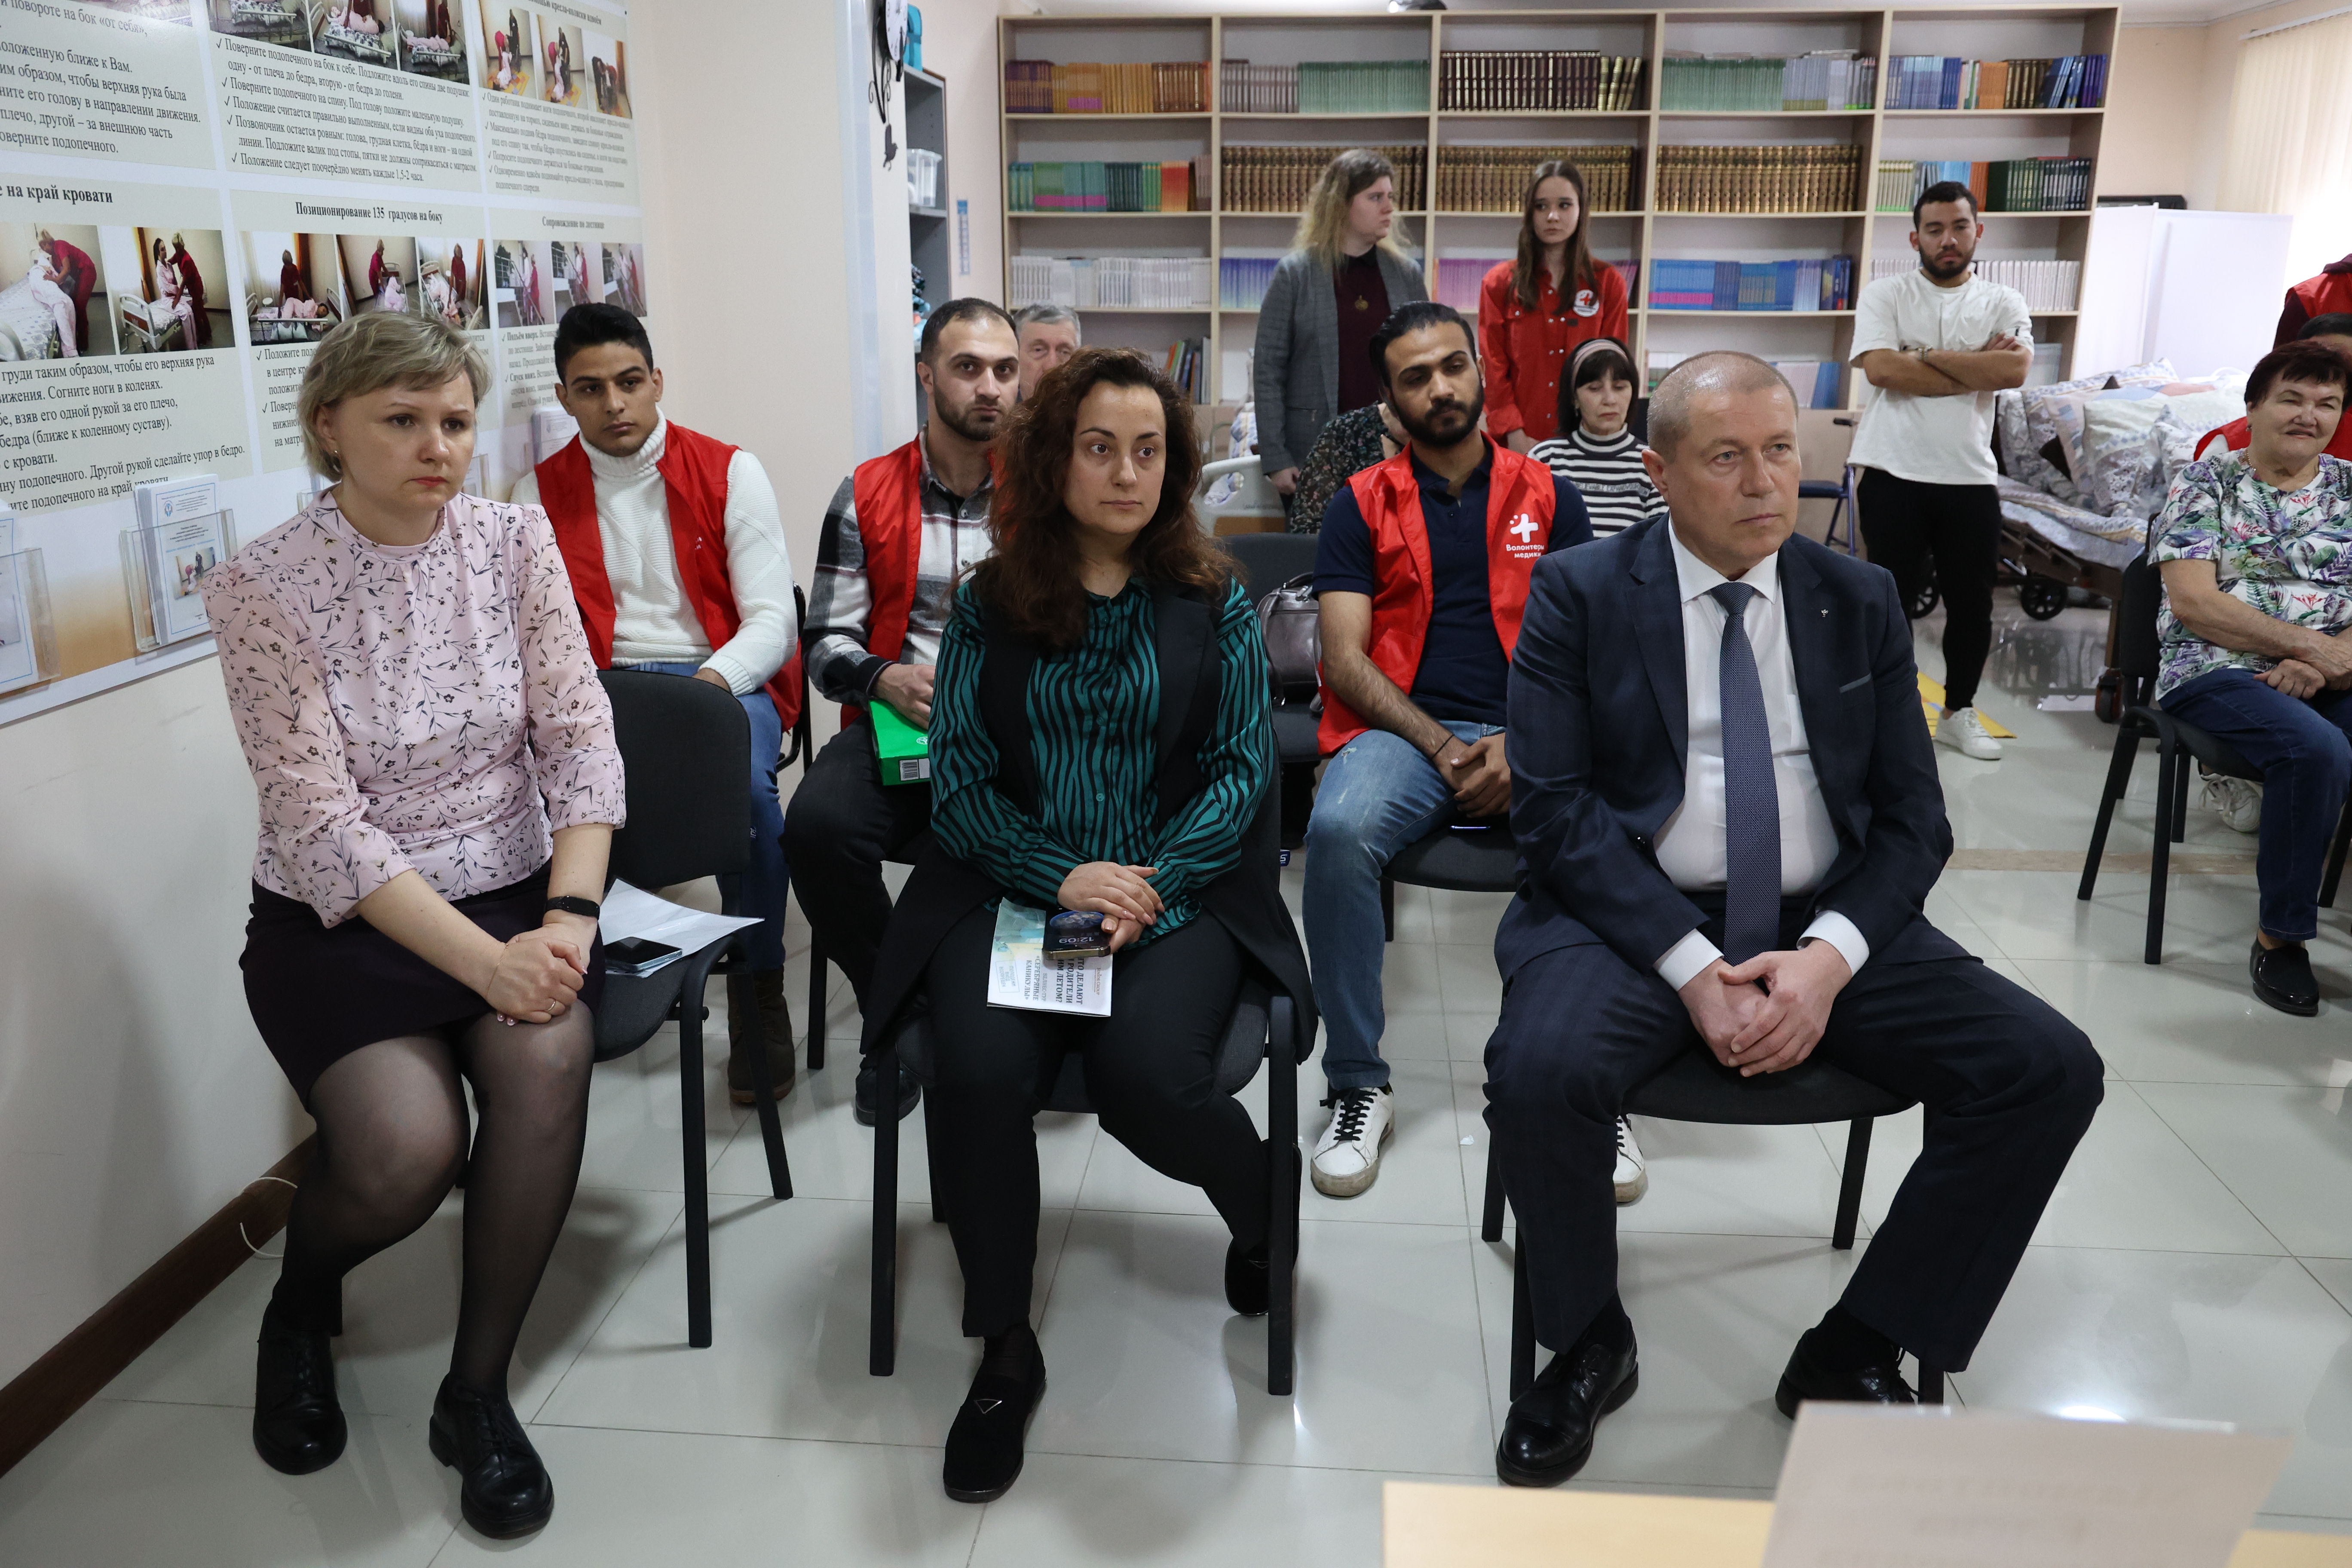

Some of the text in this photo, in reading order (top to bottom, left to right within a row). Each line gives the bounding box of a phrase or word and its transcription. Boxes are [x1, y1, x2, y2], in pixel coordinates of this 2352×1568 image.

[11, 0, 61, 17] повороте
[63, 9, 77, 20] на
[78, 9, 97, 24] бок
[99, 17, 116, 28] «от
[0, 42, 133, 72] оложенную ближе Вам.
[225, 38, 266, 57] Поверните
[268, 50, 312, 66] подопечного
[313, 59, 322, 68] на
[323, 58, 335, 70] бок
[342, 63, 358, 75] себе.
[358, 65, 392, 81] Подложите
[393, 74, 409, 84] вдоль
[18, 64, 66, 84] образом,
[67, 74, 100, 88] чтобы
[102, 80, 140, 94] верхняя
[141, 86, 163, 99] рука
[164, 86, 187, 101] была
[228, 61, 404, 100] одну от плеча до бедра, вторую от бедра до голени.
[28, 90, 45, 101] его
[47, 93, 82, 110] голову
[84, 98, 91, 108] в
[93, 100, 154, 116] направлении
[156, 109, 201, 122] движения.
[230, 77, 441, 123] Поверните подопечного на спину. Под голову положите маленькую
[0, 109, 173, 138] плечо, другой за внешнюю часть
[233, 96, 424, 135] Положение считается правильно выполненным, если видны
[52, 138, 119, 152] подопечного.
[235, 115, 429, 153] Позвоночник остается ровным: голова, грудная клетка, бёдра
[239, 137, 264, 148] линии.
[265, 137, 306, 152] Подложите
[306, 145, 326, 155] валик
[327, 148, 340, 157] под
[340, 150, 361, 159] стопы,
[362, 152, 380, 161] пятки
[389, 155, 411, 164] должны
[241, 153, 283, 168] Положение
[284, 161, 310, 172] следует
[312, 163, 349, 175] поочерёдно
[350, 167, 372, 176] менять
[373, 169, 395, 178] каждые
[396, 169, 410, 180] 1,5-2
[6, 186, 113, 204] на край кровати
[295, 202, 442, 224] Позиционирование 135 градусов на боку
[264, 349, 300, 359] Положите
[1, 357, 215, 384] груди таким образом, чтобы его верхняя рука
[273, 367, 297, 378] центре
[48, 386, 90, 398] Согните
[92, 385, 115, 395] ноги
[125, 381, 163, 392] коленях.
[15, 413, 38, 424] взяв
[41, 411, 57, 421] его
[60, 404, 90, 419] одной
[92, 401, 120, 419] рукой
[122, 403, 132, 412] за
[134, 401, 148, 411] его
[150, 398, 178, 409] плечо,
[0, 416, 172, 449] бедра (ближе коленному суставу).
[274, 436, 301, 447] на матр
[12, 454, 58, 471] кровати.
[18, 471, 87, 488] подопечного.
[90, 462, 124, 480] Другой
[126, 457, 153, 475] рукой
[154, 453, 191, 467] сделайте
[193, 450, 213, 464] упор
[221, 445, 245, 457] бедро.
[8, 500, 29, 511] ите
[31, 490, 95, 508] подопечного
[97, 487, 110, 497] на
[110, 480, 133, 497] край
[1033, 956, 1041, 1001] «СЕРЕБРЯНЫЕ
[1056, 972, 1064, 1003] ЛЕТОМ?
[1066, 962, 1074, 1004] РОДИТЕЛИ
[1076, 971, 1084, 1004] ДЕЛАЮТ
